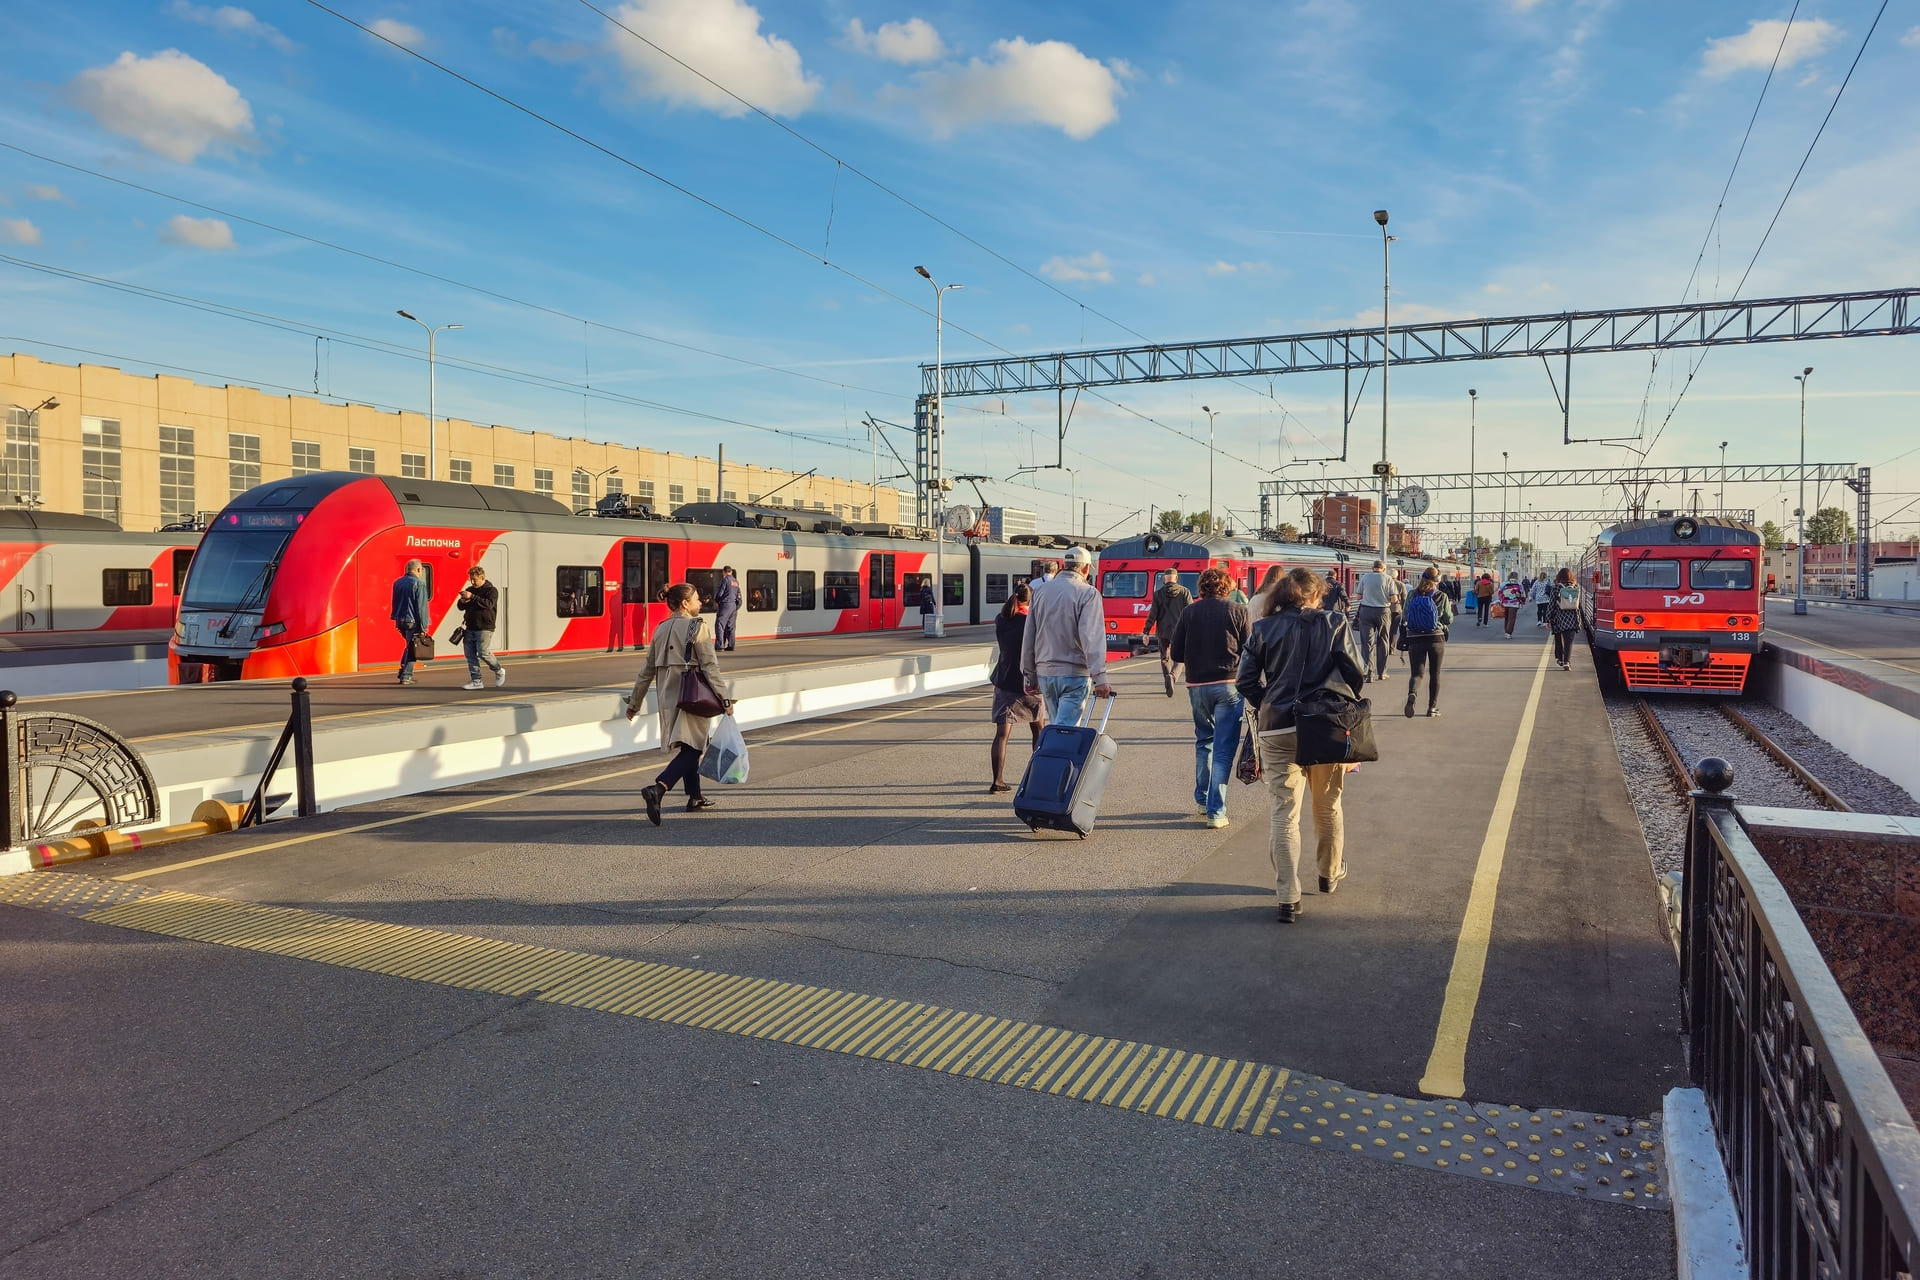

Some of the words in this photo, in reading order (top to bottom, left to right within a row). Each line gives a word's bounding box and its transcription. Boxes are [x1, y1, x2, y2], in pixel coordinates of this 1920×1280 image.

[406, 535, 461, 548] Ласточка
[1616, 630, 1645, 639] ЭТ2М
[1731, 632, 1750, 641] 138
